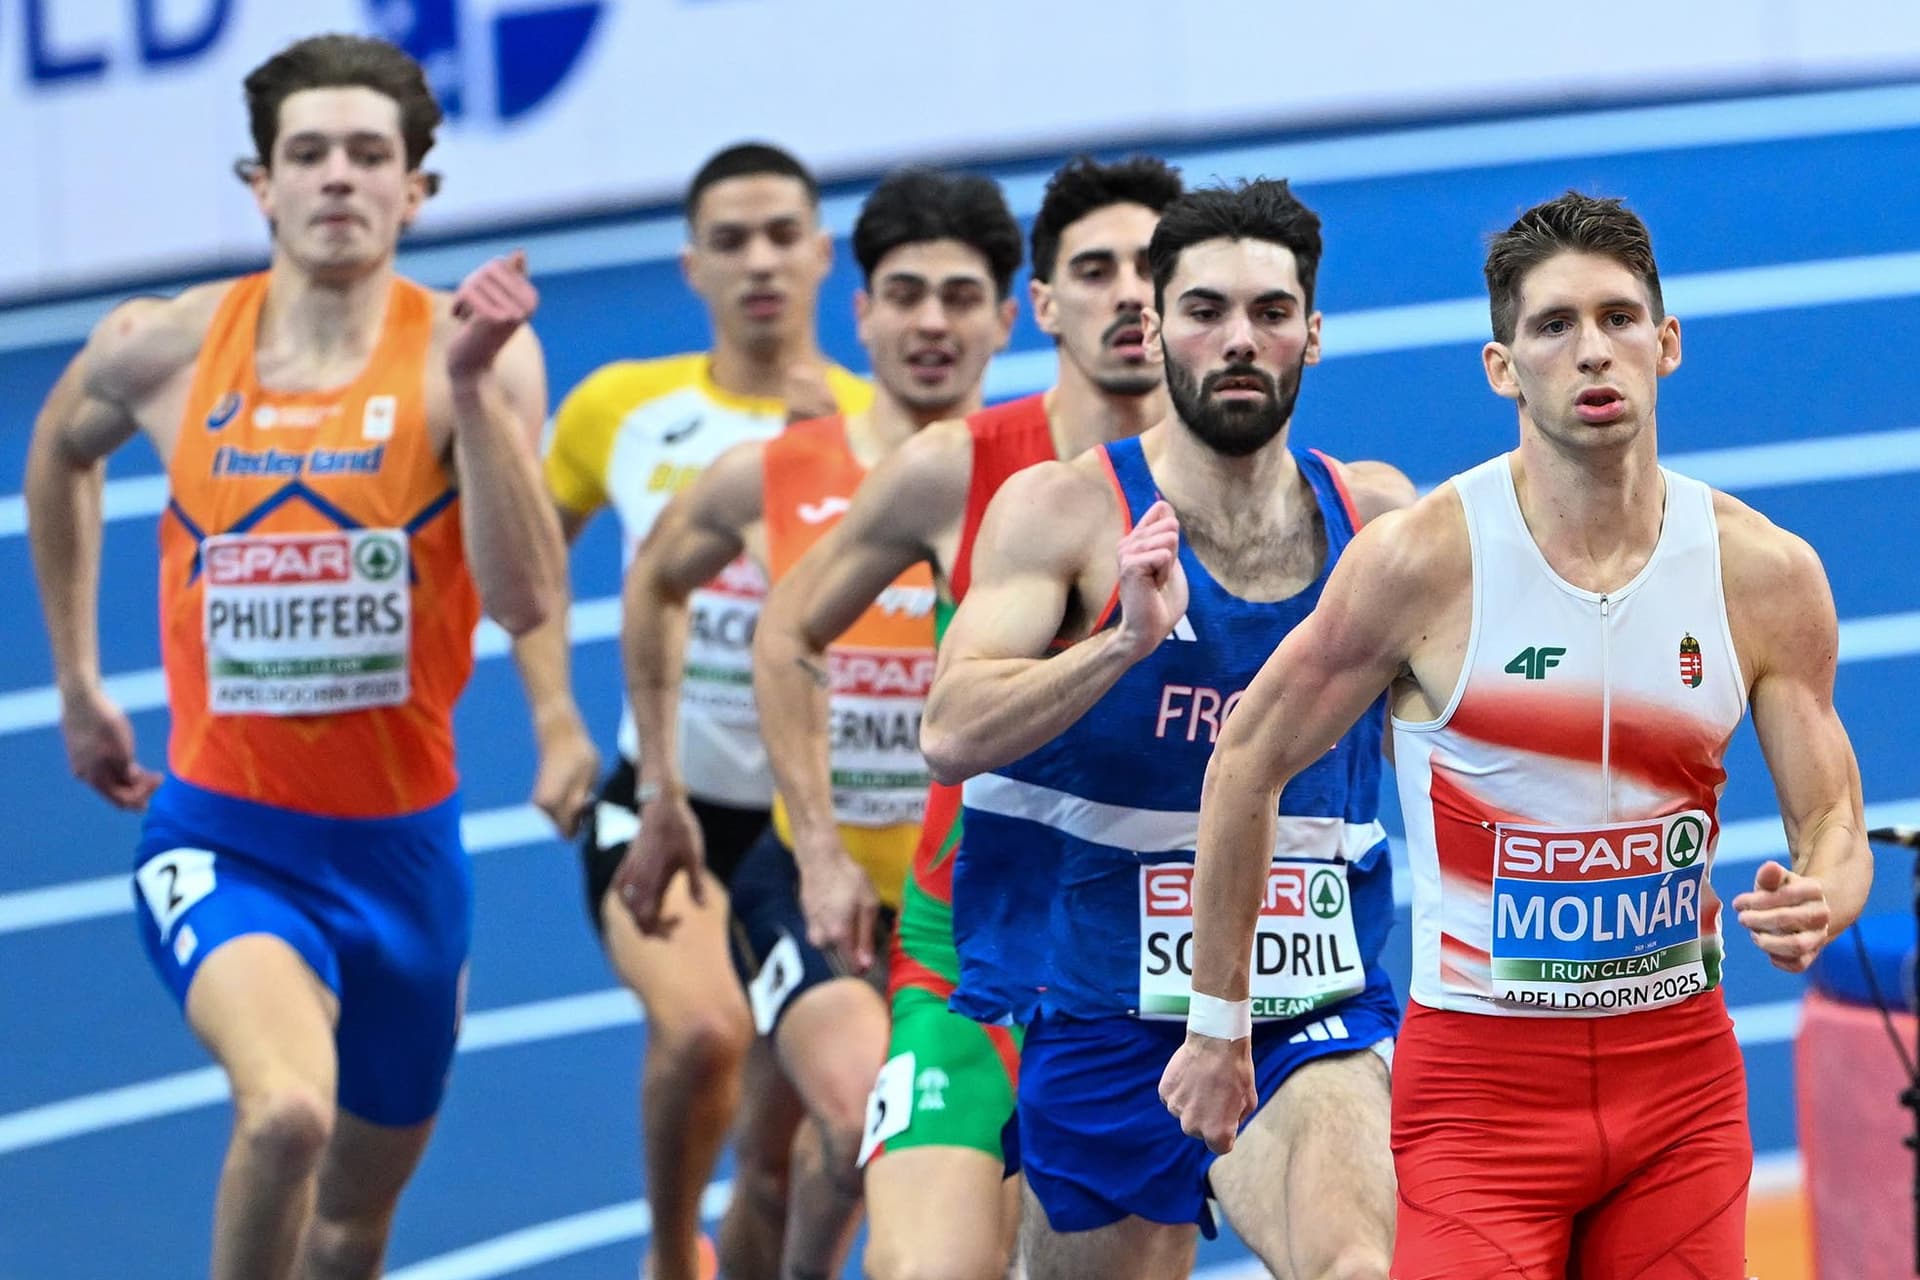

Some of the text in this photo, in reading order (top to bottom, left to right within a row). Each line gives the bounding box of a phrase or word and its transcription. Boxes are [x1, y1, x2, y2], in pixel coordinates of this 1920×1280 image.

[208, 544, 347, 582] SPAR
[1505, 647, 1566, 679] 4F
[1504, 832, 1659, 874] SPAR
[158, 863, 184, 912] 2
[1150, 874, 1302, 910] SR
[1497, 872, 1696, 942] MOLNÁR
[1541, 965, 1546, 979] I
[1552, 963, 1597, 980] RUN
[1504, 973, 1700, 1009] APELDOORN 2025
